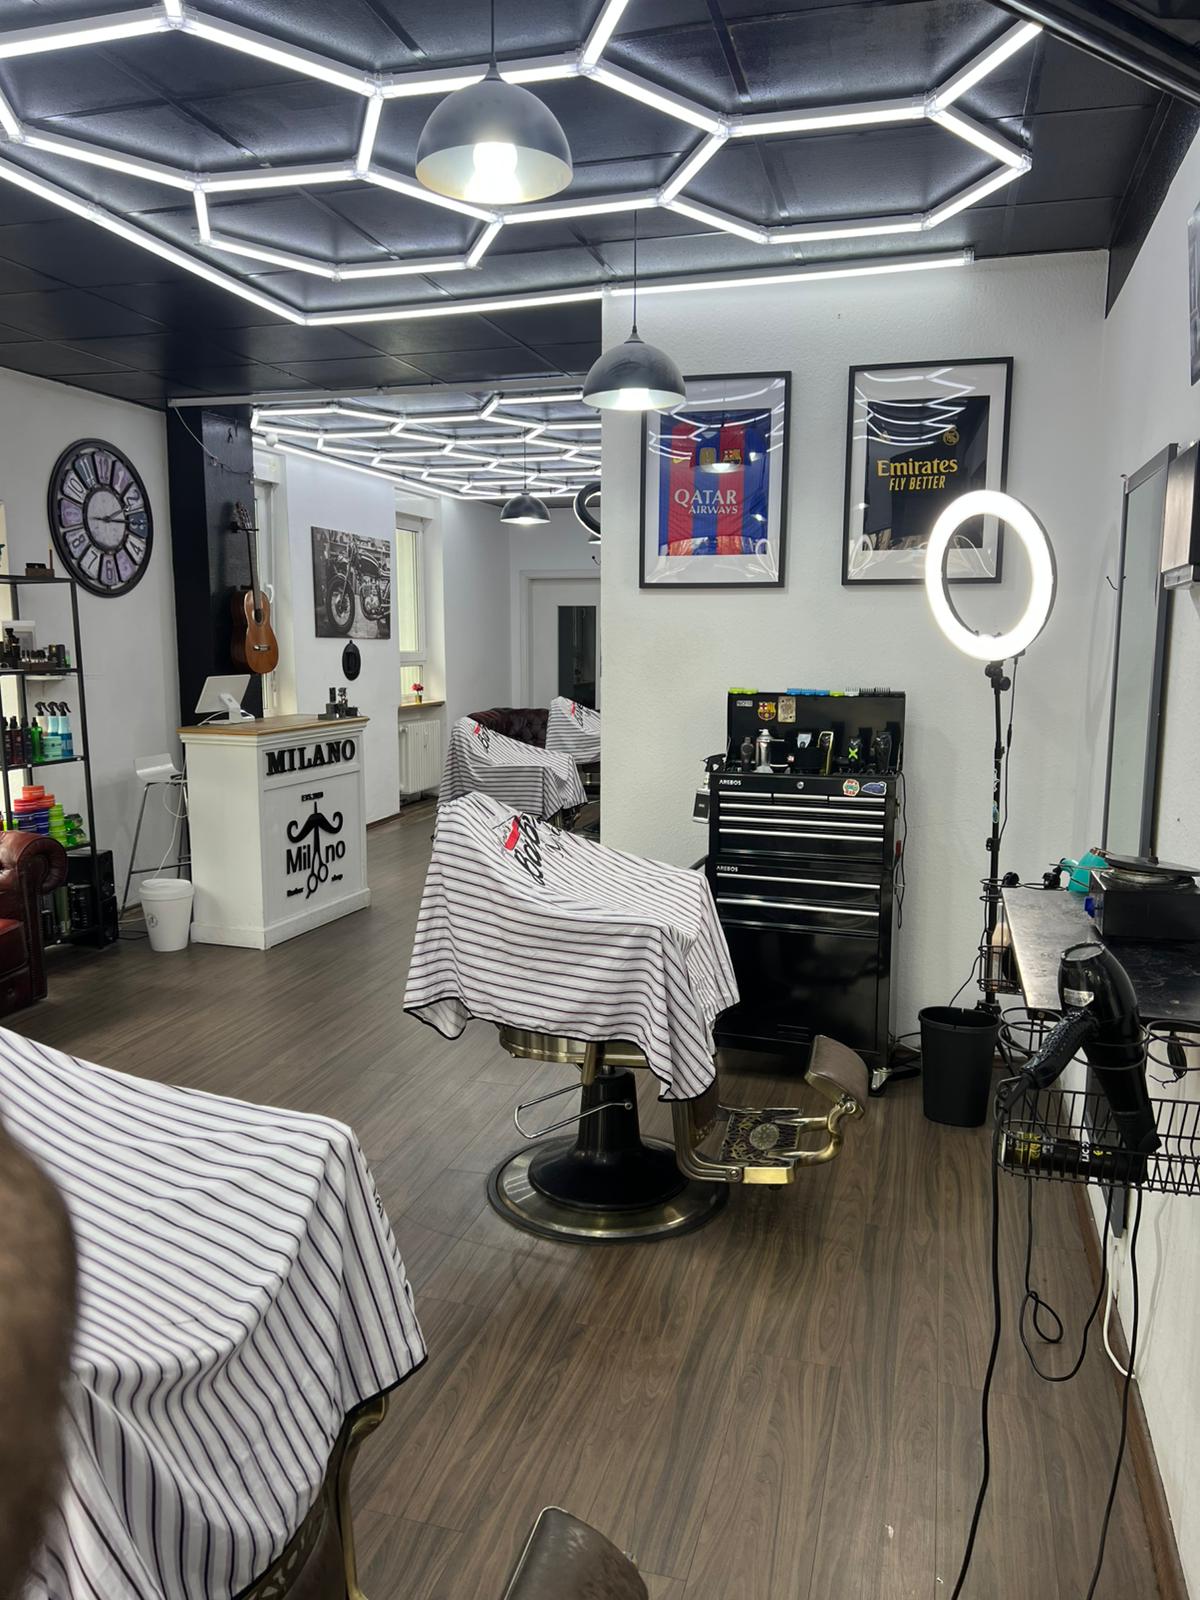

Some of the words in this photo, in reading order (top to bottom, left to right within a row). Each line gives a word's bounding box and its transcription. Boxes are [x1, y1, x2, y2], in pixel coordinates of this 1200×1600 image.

[877, 458, 958, 476] Emirates
[67, 478, 85, 499] 10
[889, 477, 906, 491] FLY
[909, 475, 946, 490] BETTER
[674, 488, 737, 508] QATAR
[688, 504, 738, 514] AIRWAYS
[72, 534, 85, 549] 8
[129, 540, 144, 556] 4
[87, 550, 99, 570] 7
[105, 560, 113, 581] 6
[266, 739, 355, 776] MILANO
